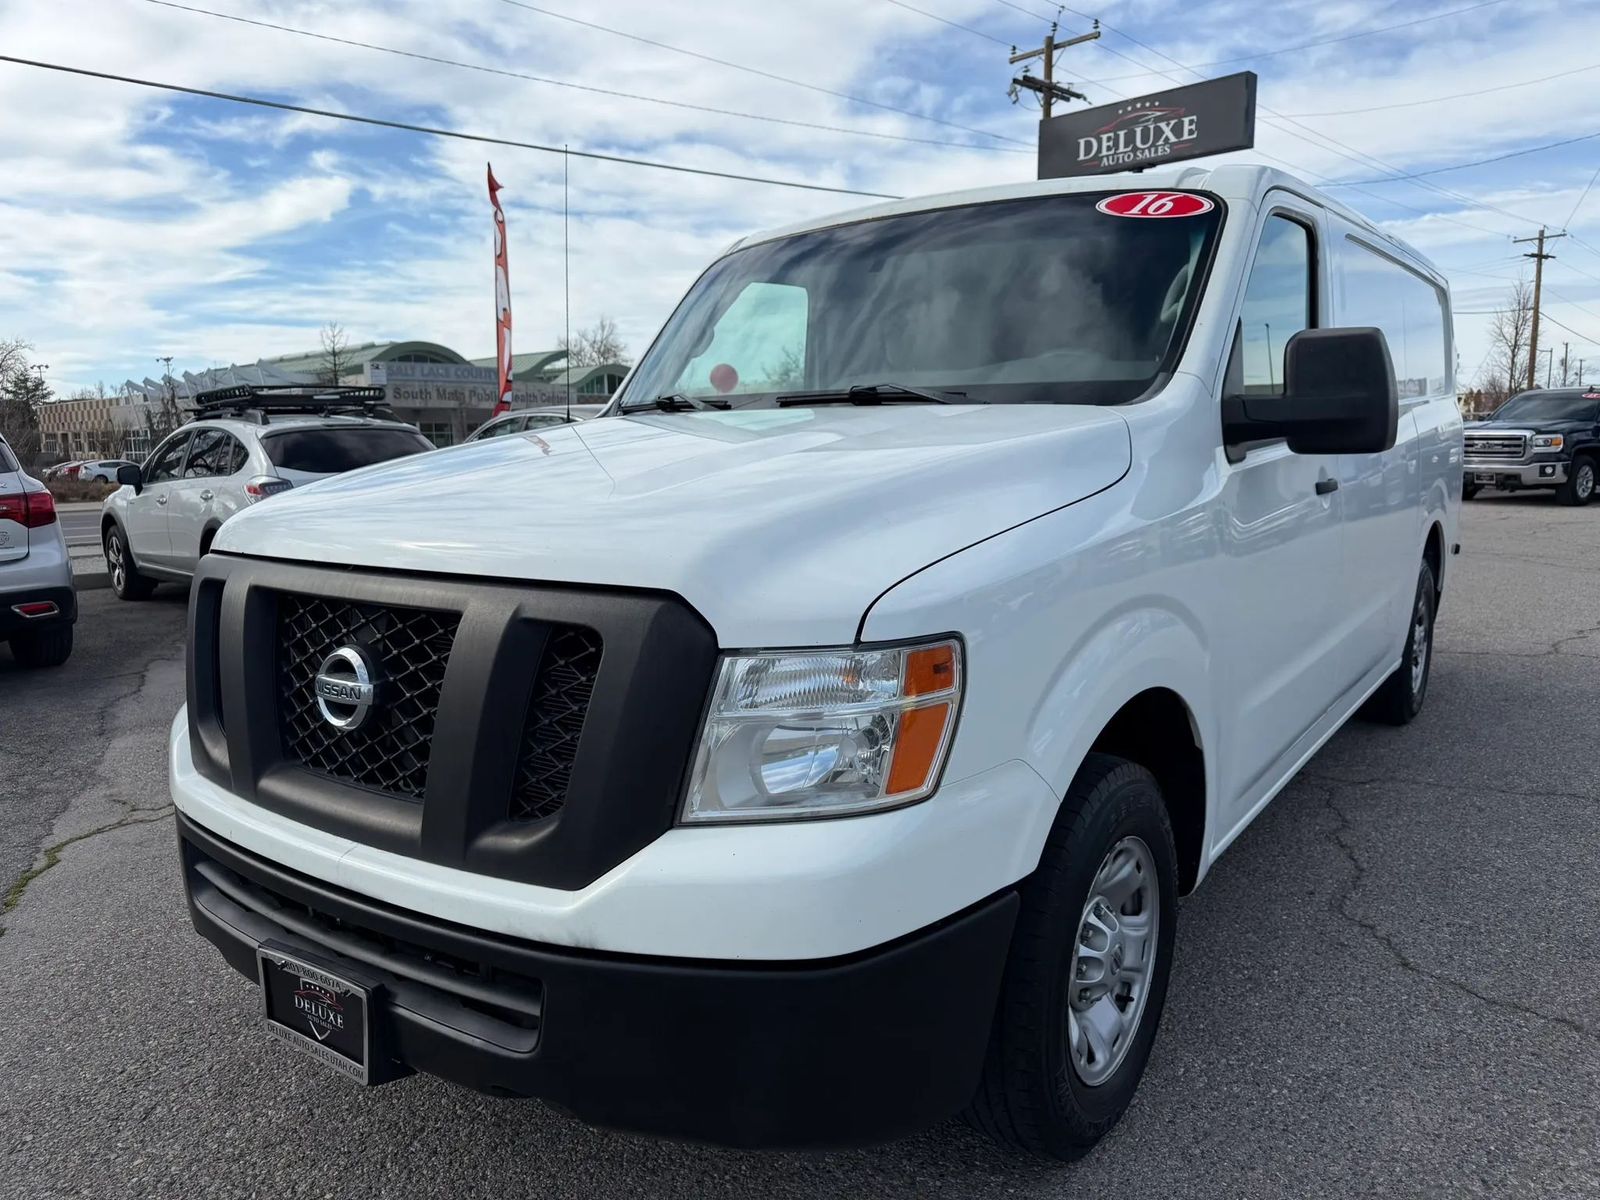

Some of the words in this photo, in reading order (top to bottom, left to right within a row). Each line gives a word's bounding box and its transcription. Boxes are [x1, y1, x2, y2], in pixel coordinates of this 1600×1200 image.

[1077, 115, 1198, 161] DELUXE
[1101, 151, 1134, 167] AUTO
[1136, 143, 1171, 160] SALES
[1123, 194, 1184, 215] 16
[387, 366, 415, 378] SALT
[393, 387, 432, 400] South
[436, 388, 466, 401] Main
[469, 388, 499, 402] Publi
[315, 680, 361, 700] NISSAN
[294, 995, 344, 1029] DELUXE
[267, 1023, 292, 1041] DELUXE
[293, 1036, 310, 1051] AUTO
[310, 1045, 330, 1061] SALES
